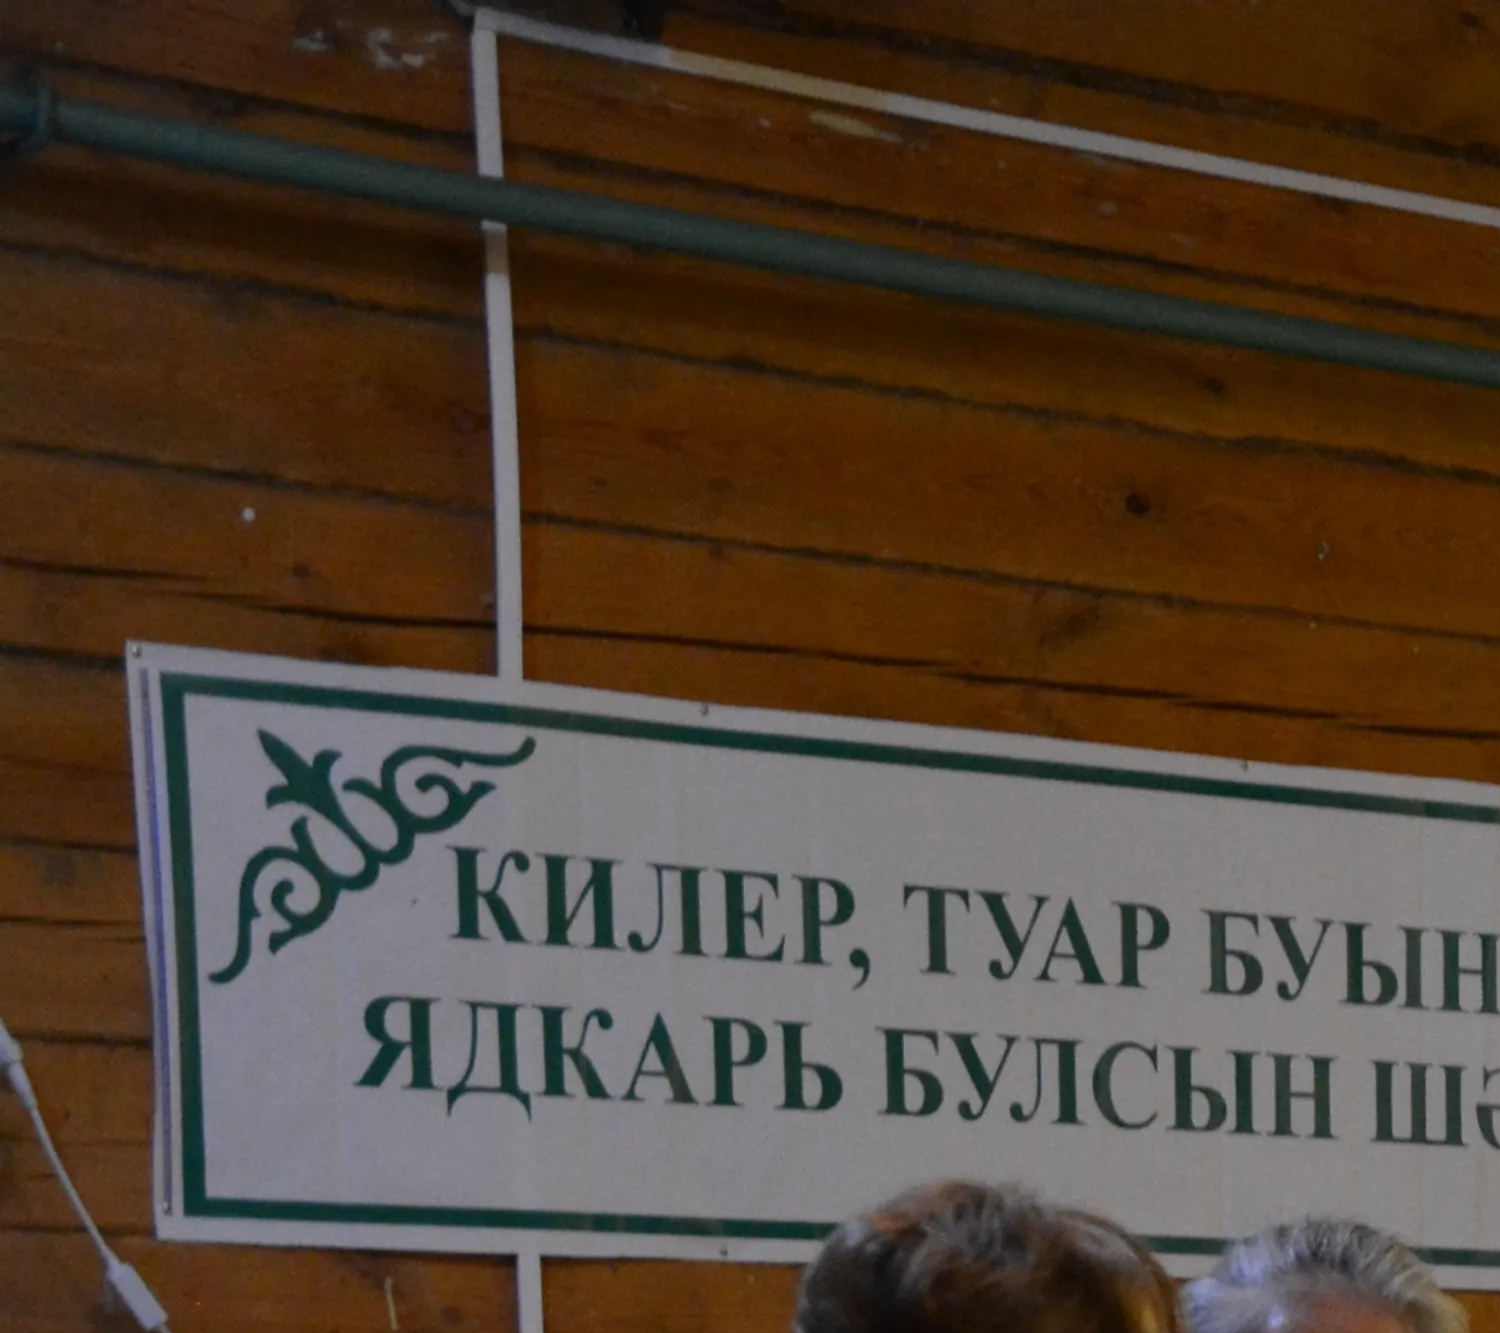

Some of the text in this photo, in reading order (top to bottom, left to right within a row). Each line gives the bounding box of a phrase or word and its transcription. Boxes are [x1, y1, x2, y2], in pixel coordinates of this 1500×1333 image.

[445, 845, 873, 990] КИЛЕР,
[902, 883, 1172, 990] ТУАР
[352, 995, 845, 1120] ЯДКАРЬ
[874, 1025, 1341, 1141] БУЛСЫН
